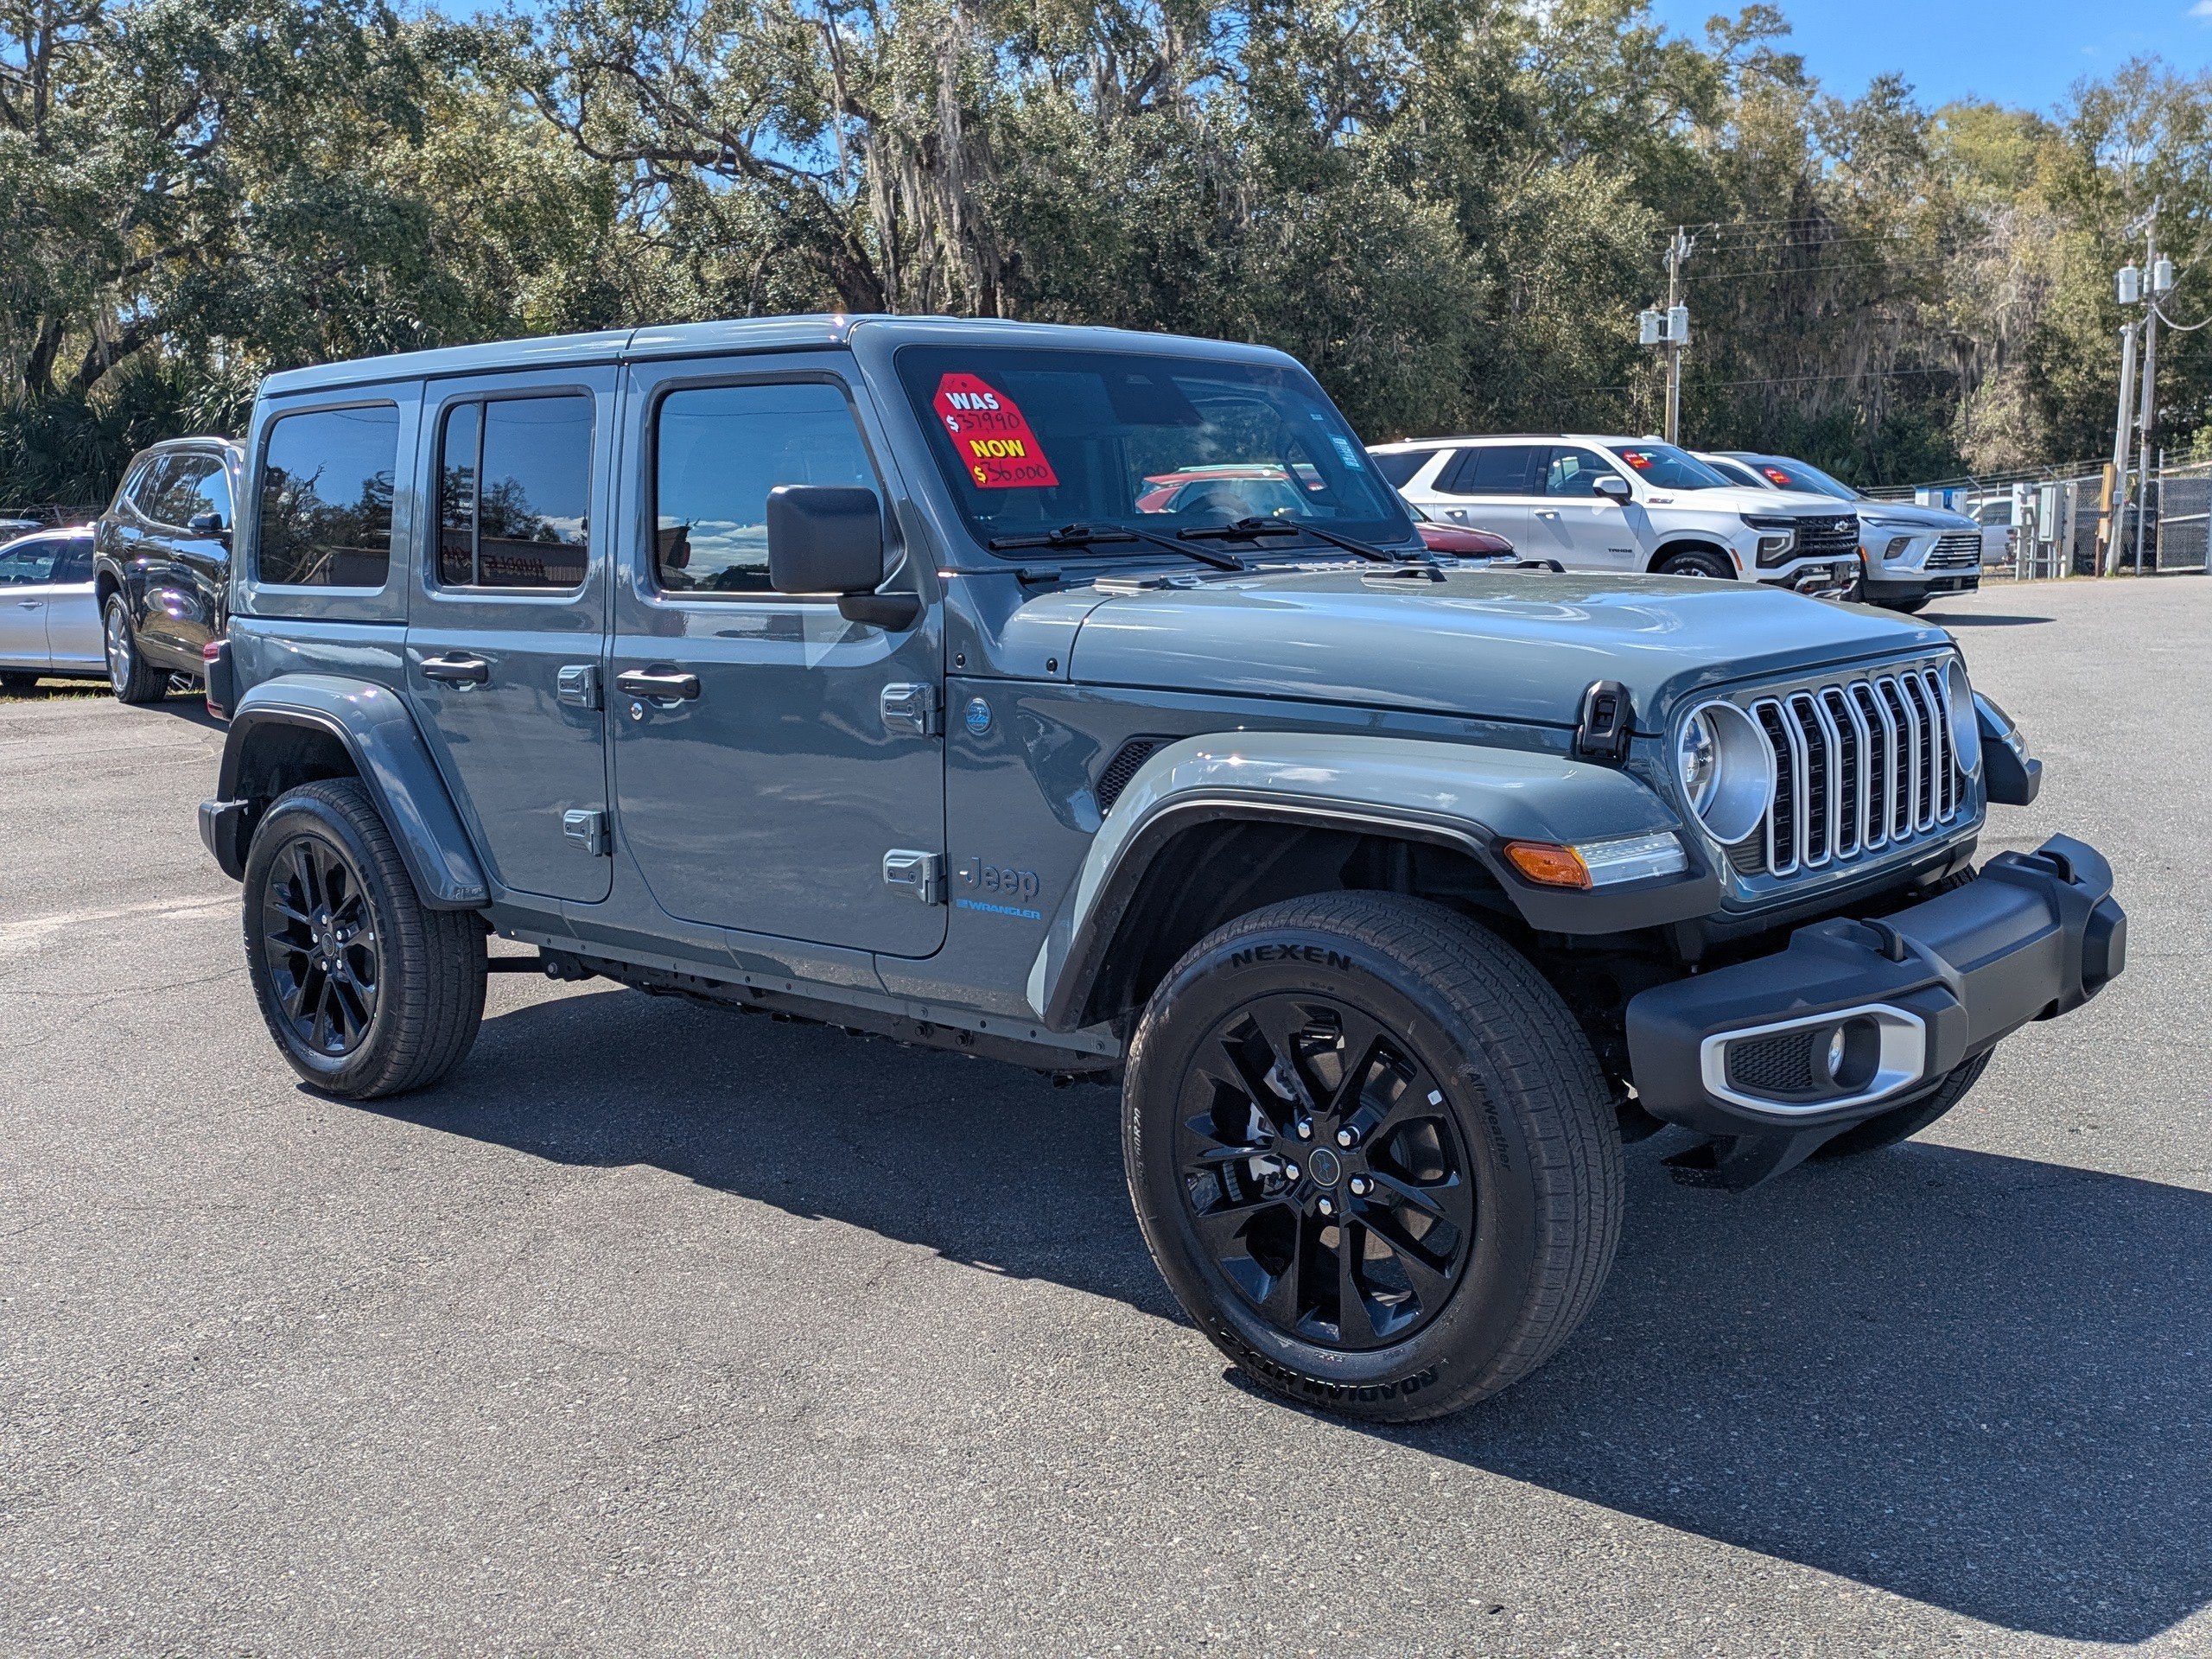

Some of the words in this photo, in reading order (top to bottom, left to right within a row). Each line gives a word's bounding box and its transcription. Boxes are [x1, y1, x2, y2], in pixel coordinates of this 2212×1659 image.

[945, 392, 1001, 410] WAS
[969, 439, 1027, 458] NOW
[959, 856, 1039, 903] Jeep
[968, 900, 1041, 921] WRANGLER
[1230, 944, 1352, 971] NEXEN
[1467, 1071, 1512, 1173] All-Weather
[1302, 1363, 1440, 1402] ROADIAN
